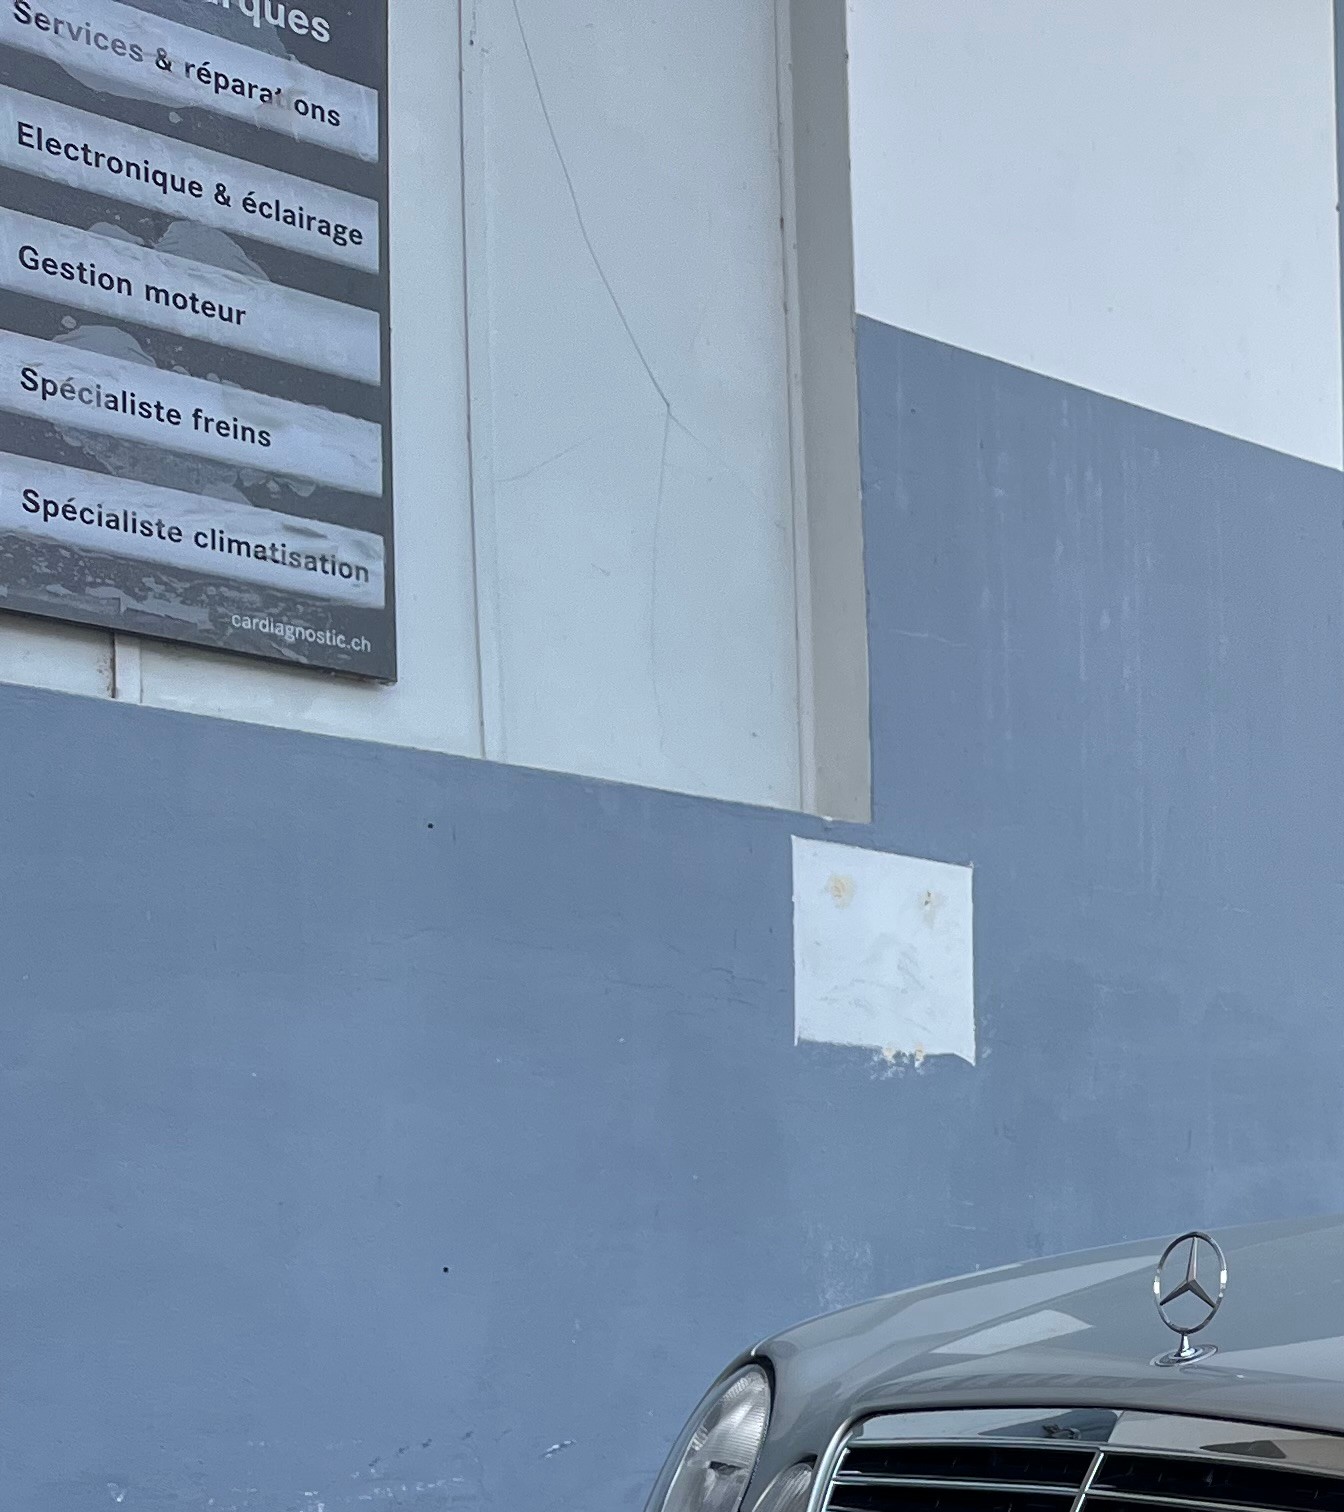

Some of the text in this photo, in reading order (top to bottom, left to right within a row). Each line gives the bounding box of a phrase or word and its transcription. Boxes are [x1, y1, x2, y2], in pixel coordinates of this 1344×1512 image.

[206, 0, 331, 43] ques
[13, 0, 341, 127] Services & réparaons
[17, 121, 364, 247] Electronique & éclairage
[18, 245, 247, 326] Gestion moteur
[20, 367, 272, 448] Spécialiste freins
[22, 488, 370, 583] Spécialiste climatisation
[231, 612, 372, 653] cardiagnostic.ch
